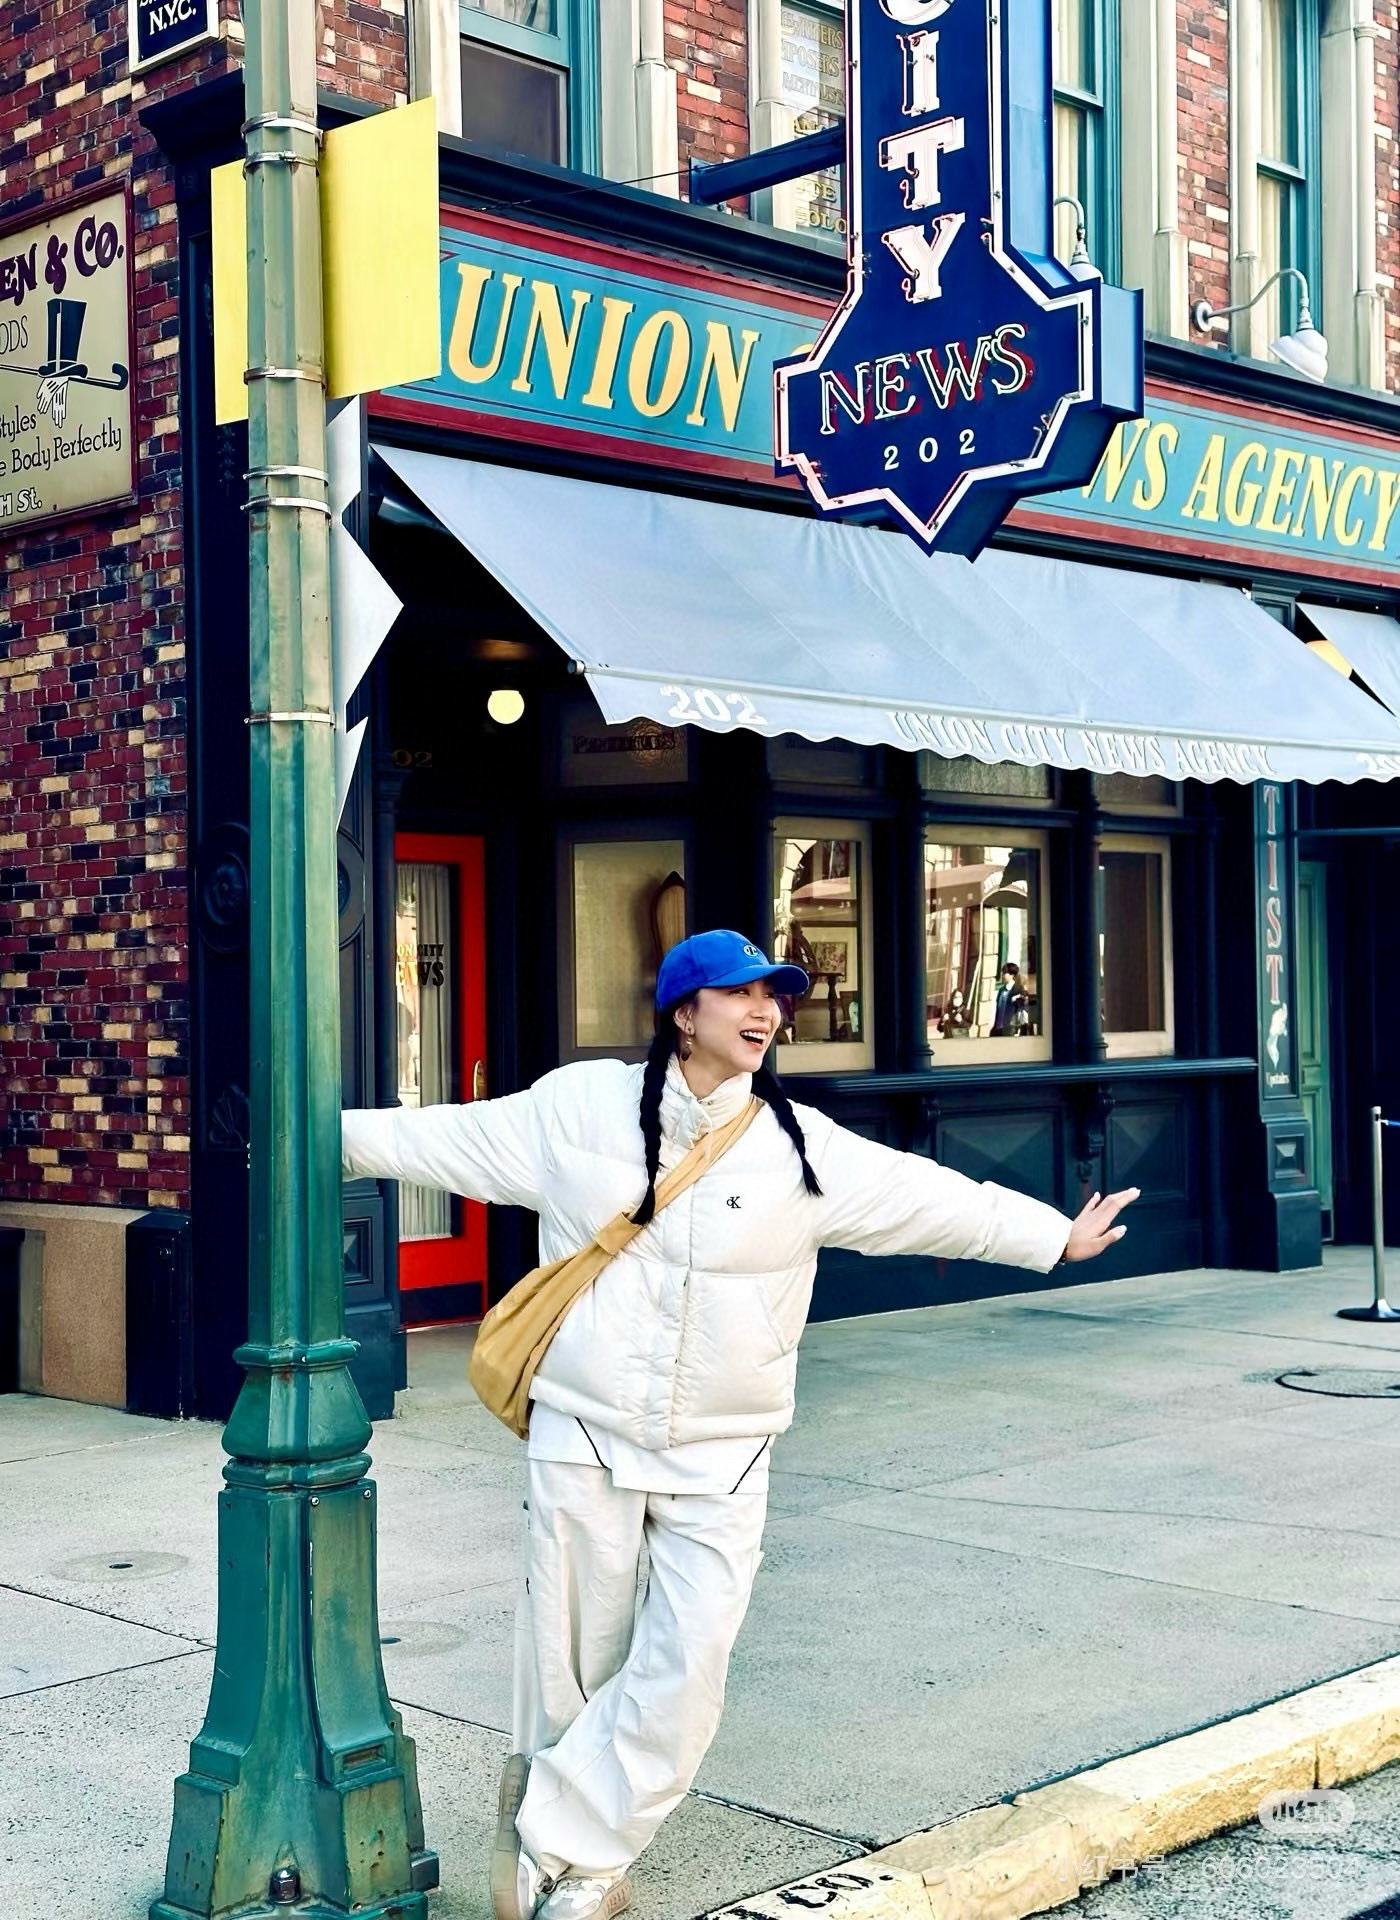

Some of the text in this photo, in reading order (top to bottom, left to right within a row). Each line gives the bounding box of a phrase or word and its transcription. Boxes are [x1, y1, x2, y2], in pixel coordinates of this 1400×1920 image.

[149, 0, 197, 36] N.Y.C.
[878, 0, 966, 304] ITY
[448, 262, 762, 433] UNION
[820, 323, 1036, 436] NEWS
[0, 405, 37, 443] tyles
[12, 436, 51, 473] Body
[53, 417, 121, 462] Perfectly
[659, 683, 769, 727] 202
[885, 711, 1277, 776] UNION CITY NEWS AGENCY
